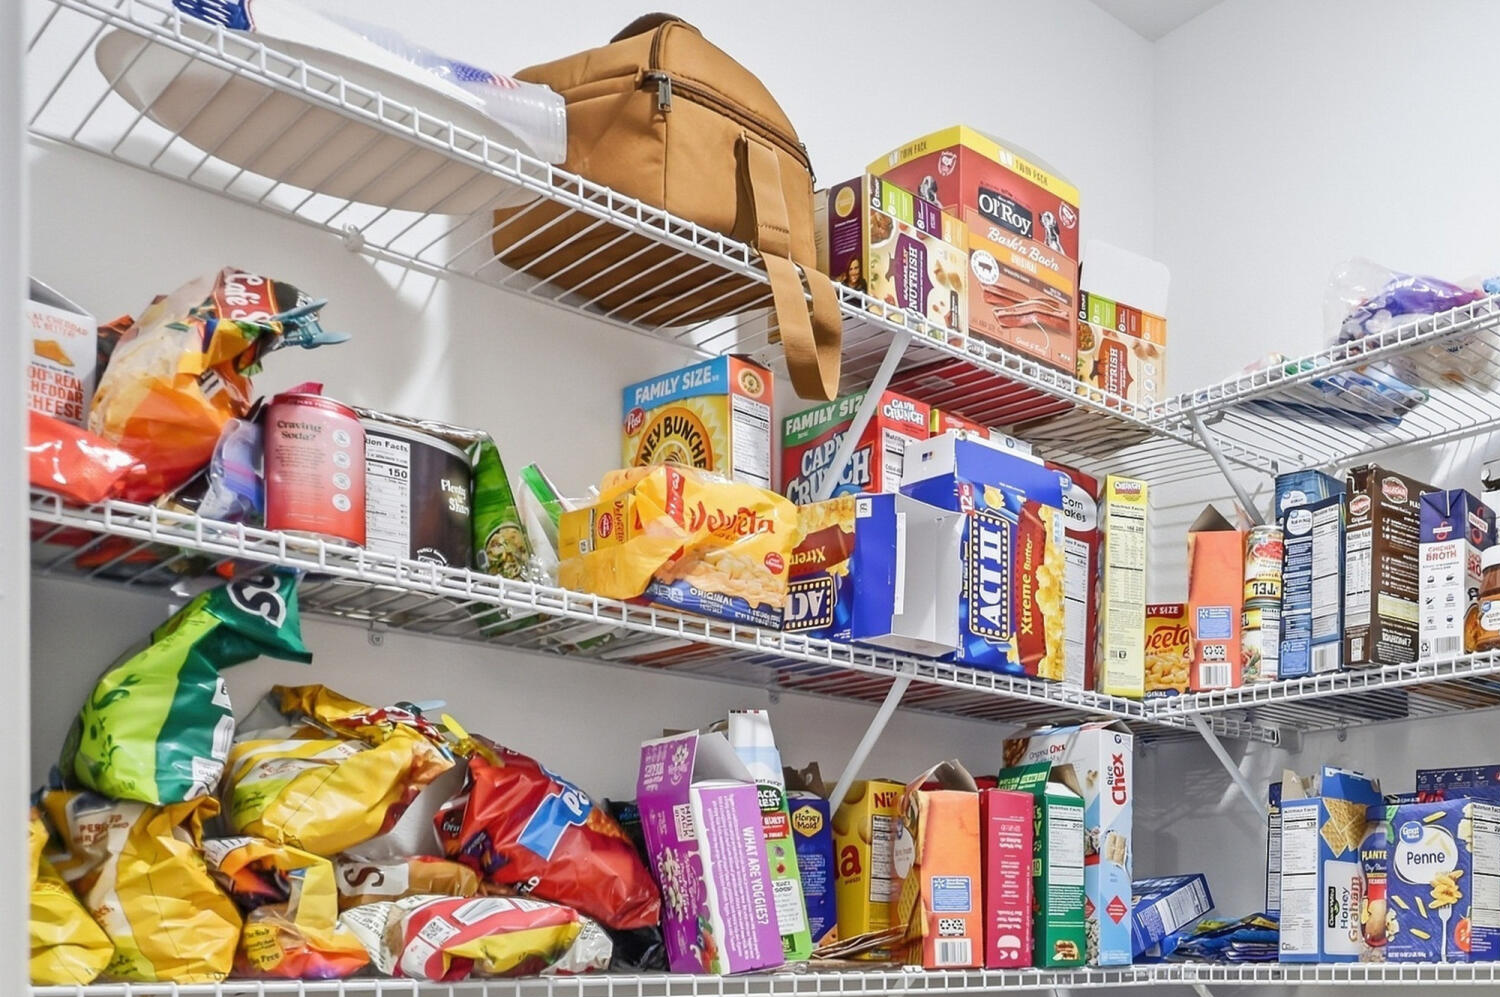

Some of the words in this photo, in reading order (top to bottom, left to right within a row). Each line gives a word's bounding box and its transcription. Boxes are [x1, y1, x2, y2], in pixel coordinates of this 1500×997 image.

[28, 379, 84, 405] HEDDAR
[54, 372, 84, 393] REAL
[635, 376, 680, 406] FAMILY
[682, 365, 712, 391] SIZE
[624, 408, 645, 436] Post
[785, 404, 836, 436] FAMILY
[883, 404, 924, 426] CRUNCH
[276, 420, 322, 433] Craving
[281, 431, 316, 442] Soda?
[663, 415, 707, 468] BUNCHE
[388, 467, 409, 480] 150
[962, 496, 973, 513] 12
[1063, 494, 1084, 511] Corn
[1064, 508, 1087, 523] akes
[1023, 538, 1033, 572] Butter
[1425, 551, 1457, 562] BROTH
[1427, 544, 1456, 553] CHICKEN
[979, 564, 1001, 629] ACT
[1020, 572, 1033, 636] Xtreme
[1159, 606, 1179, 615] SIZE
[1049, 743, 1066, 754] Chex
[1106, 765, 1114, 786] Rice
[1111, 752, 1128, 806] Chex
[757, 791, 777, 800] ACK
[677, 806, 690, 838] PACK
[684, 805, 696, 838] MULTI
[794, 813, 823, 824] Honey
[742, 826, 757, 855] WHAT
[1361, 850, 1388, 861] PLANTE
[1407, 851, 1446, 865] Penne
[747, 857, 760, 877] ARE
[752, 877, 769, 925] YOGGIES?
[1340, 886, 1350, 929] Honey
[1348, 876, 1360, 942] Graham
